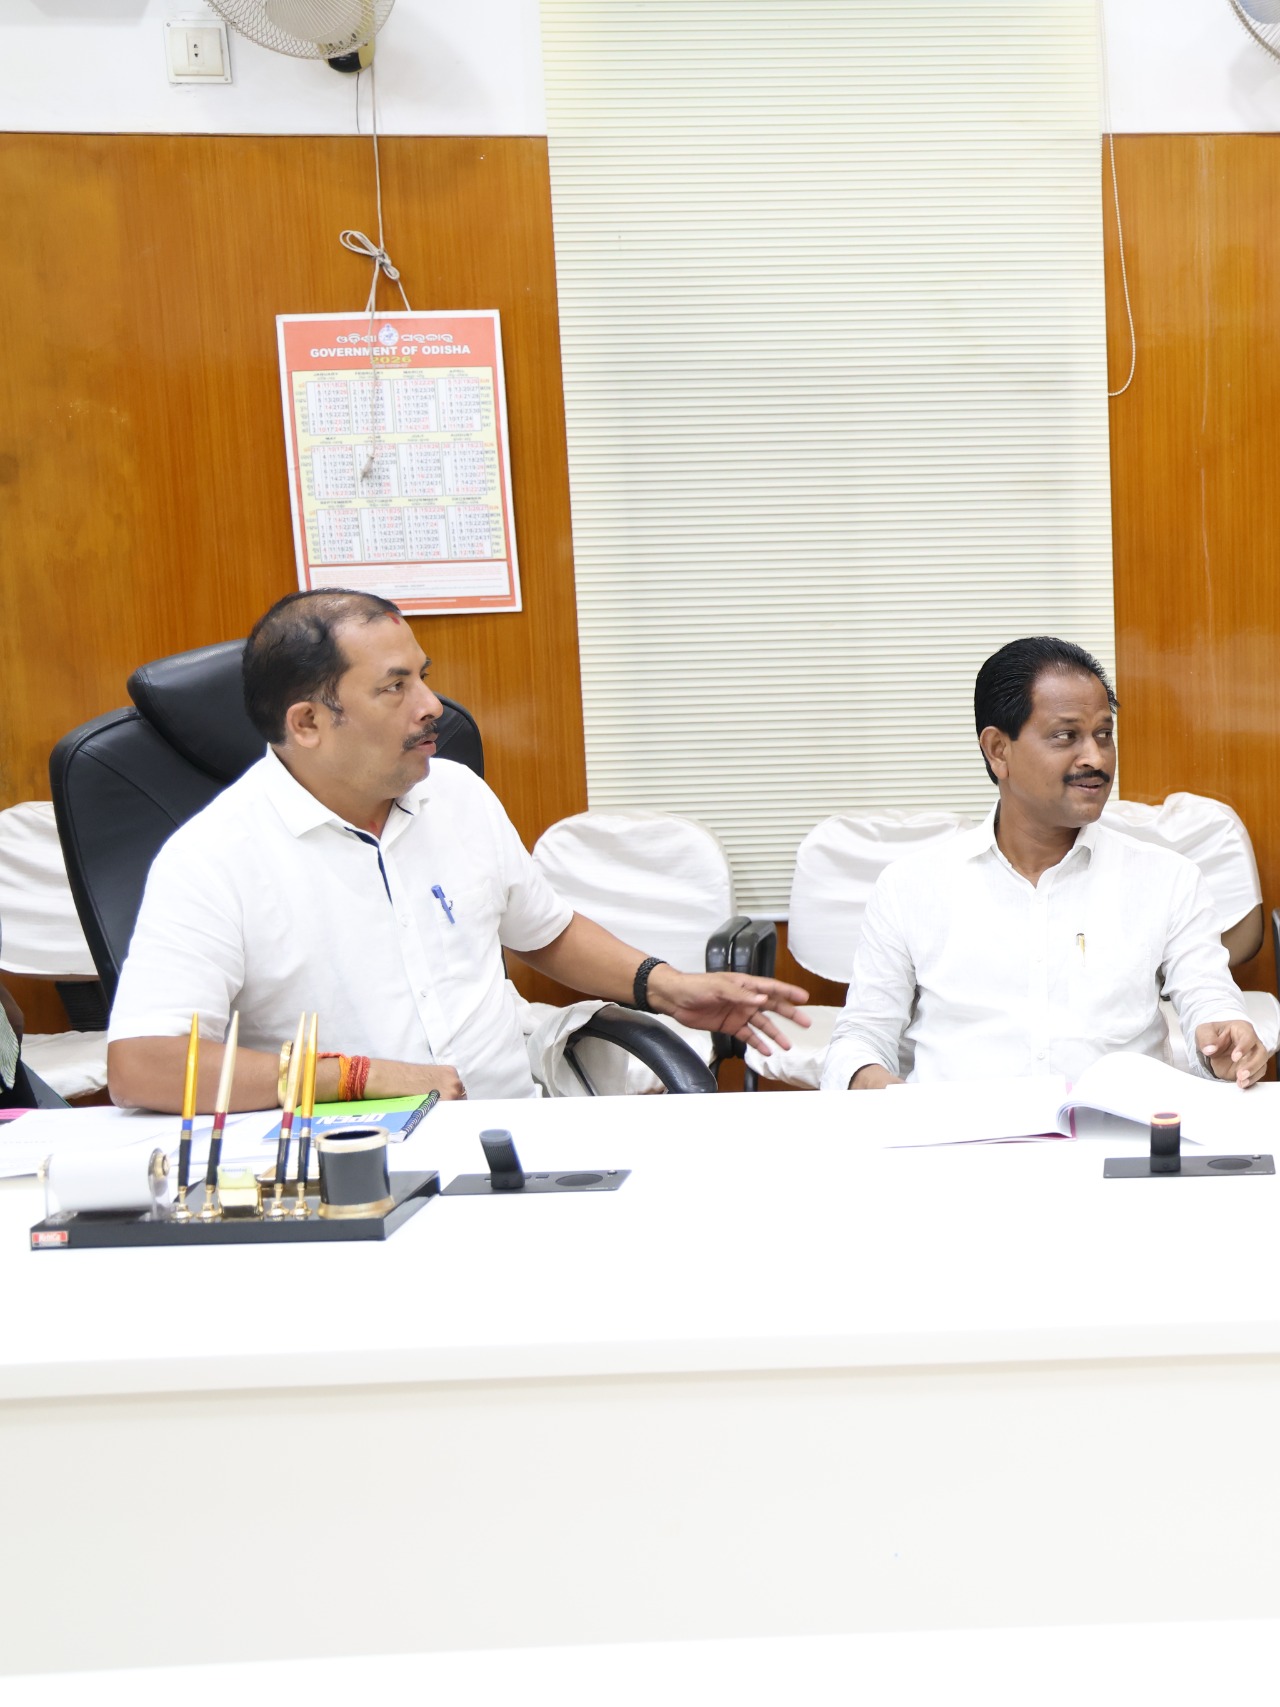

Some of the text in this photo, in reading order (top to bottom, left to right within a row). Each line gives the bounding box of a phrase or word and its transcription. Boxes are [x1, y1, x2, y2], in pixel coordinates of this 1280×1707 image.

[310, 345, 470, 358] GOVERNMENT OF ODISHA
[316, 1112, 386, 1126] OPEN
